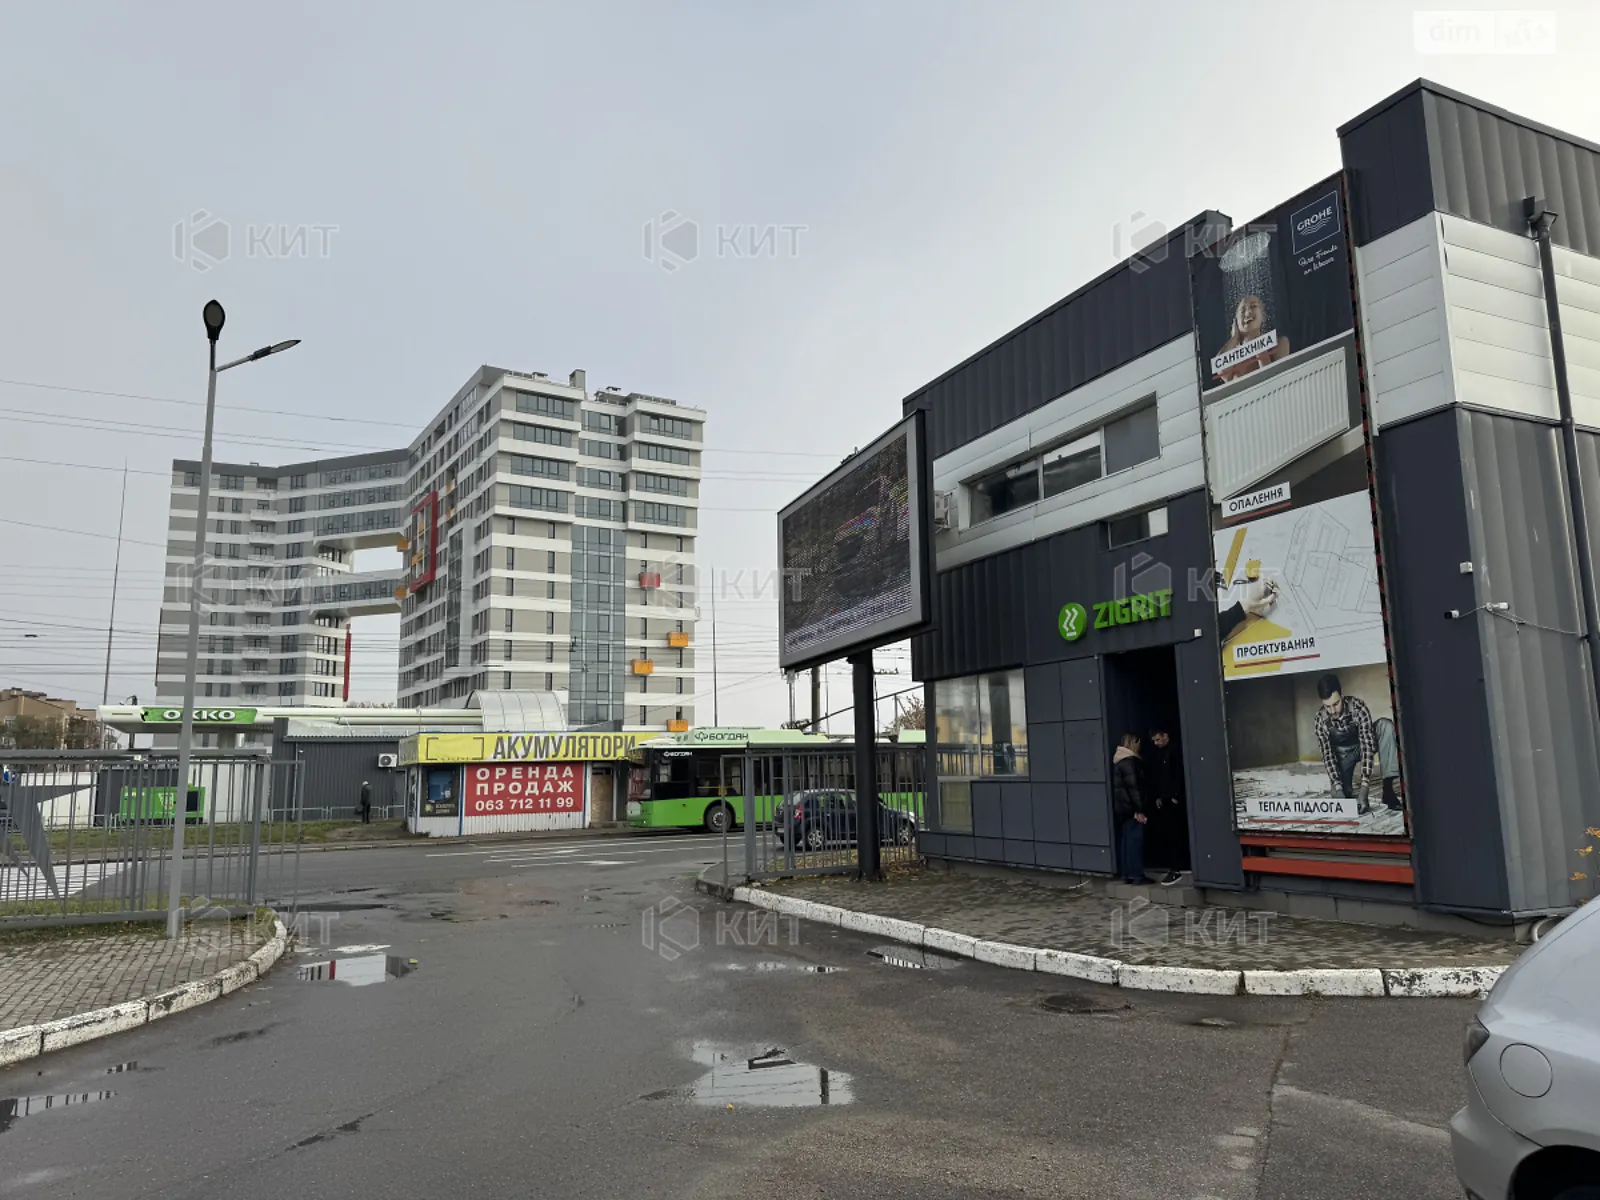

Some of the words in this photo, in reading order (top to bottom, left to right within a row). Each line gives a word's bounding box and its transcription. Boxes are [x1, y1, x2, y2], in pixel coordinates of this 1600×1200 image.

[1297, 206, 1333, 231] GROHE
[1214, 335, 1274, 368] САНТЕХНІКА
[1228, 487, 1284, 511] ОПАЛЕННЯ
[1092, 588, 1173, 629] ZIGRIT
[1236, 636, 1316, 658] ПРОЕКТУВАННЯ
[493, 735, 635, 760] АКУМУЛЯТОРИ
[709, 733, 748, 741] БОГДАН
[476, 766, 574, 780] ОРЕНДА
[476, 781, 574, 796] ПРОДАЖ
[475, 800, 504, 811] 063
[510, 799, 533, 810] 712
[538, 798, 551, 809] 11
[556, 797, 574, 808] 99
[1258, 800, 1291, 812] ТЕПЛА
[1294, 801, 1344, 815] ПІДЛОГА
